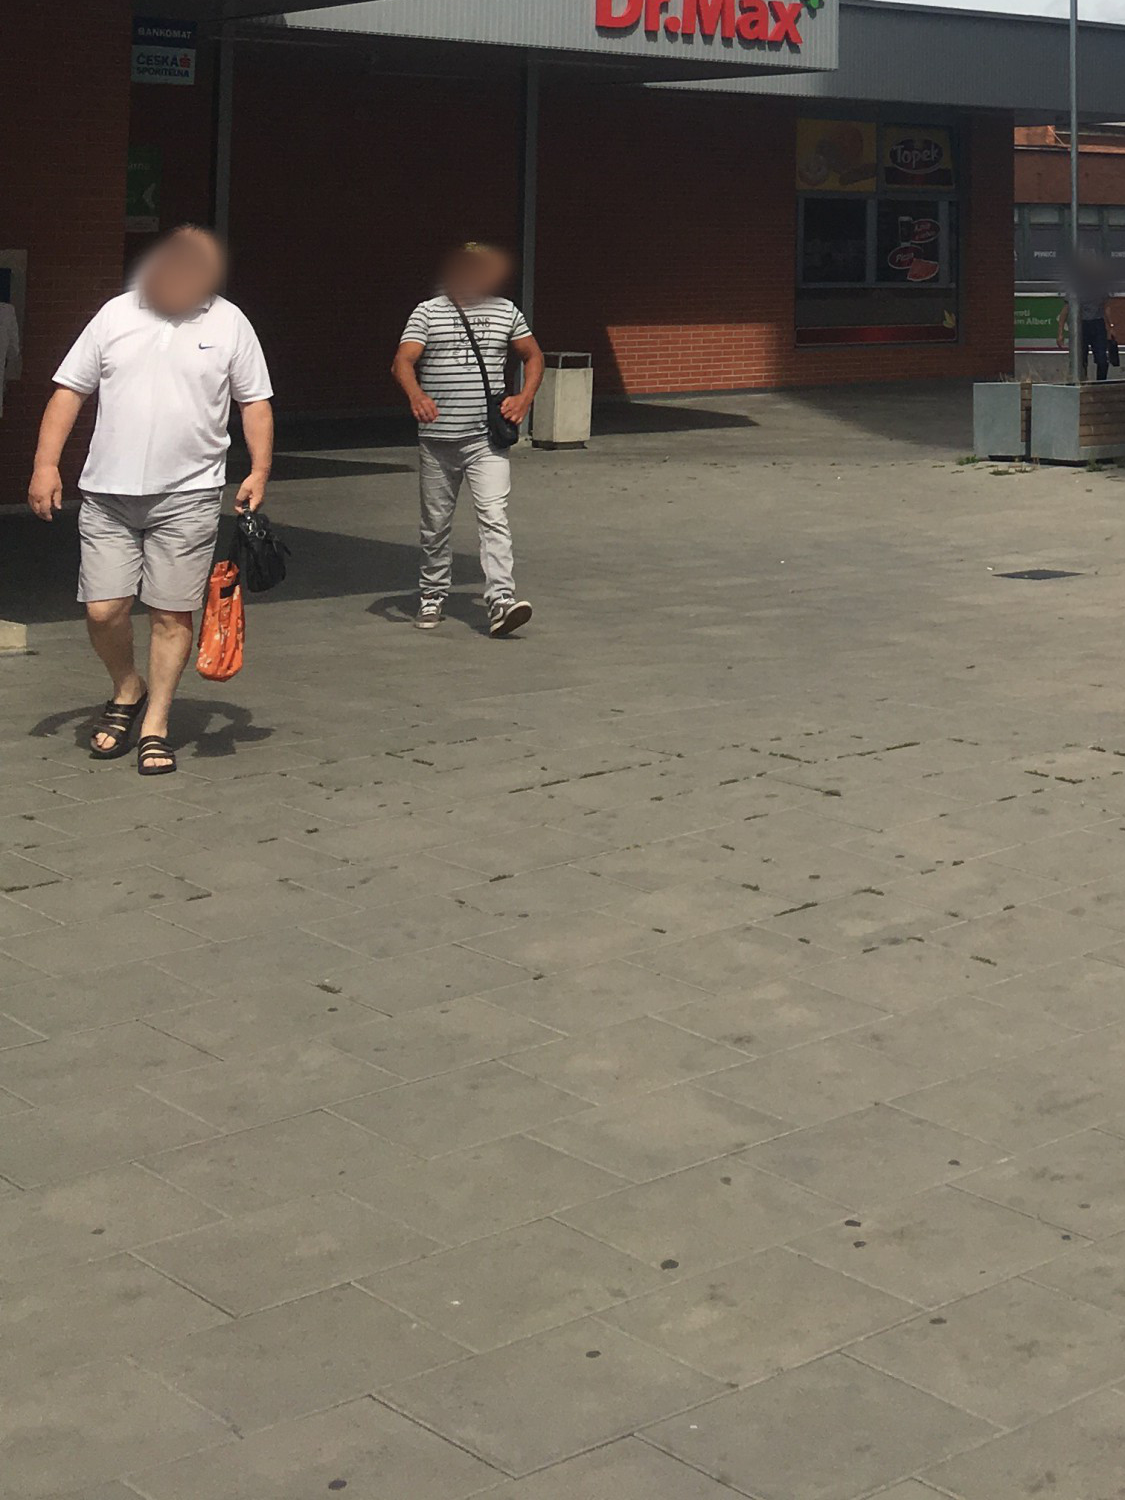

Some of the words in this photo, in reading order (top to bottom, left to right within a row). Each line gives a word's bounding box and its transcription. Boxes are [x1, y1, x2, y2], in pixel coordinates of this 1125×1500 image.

[137, 26, 192, 40] BANKOMAT
[892, 143, 938, 169] Topek
[1026, 317, 1051, 325] Albert
